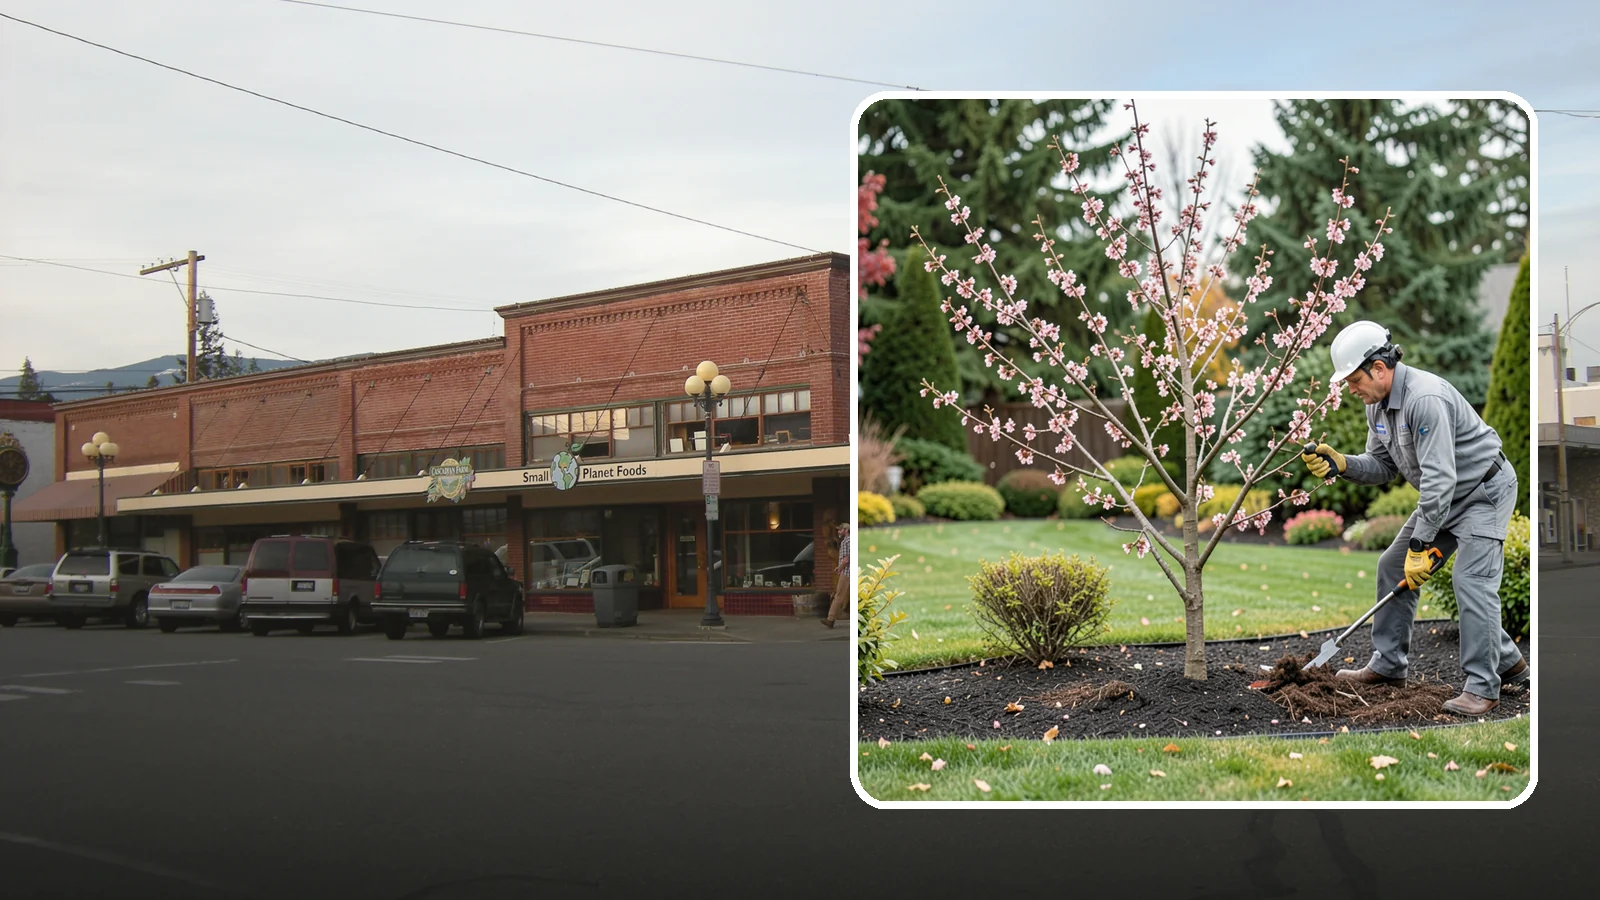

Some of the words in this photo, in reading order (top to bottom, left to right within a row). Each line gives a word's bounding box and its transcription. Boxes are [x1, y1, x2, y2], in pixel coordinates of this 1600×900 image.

[523, 471, 549, 483] Small
[582, 467, 614, 479] Planet
[617, 464, 647, 477] Foods
